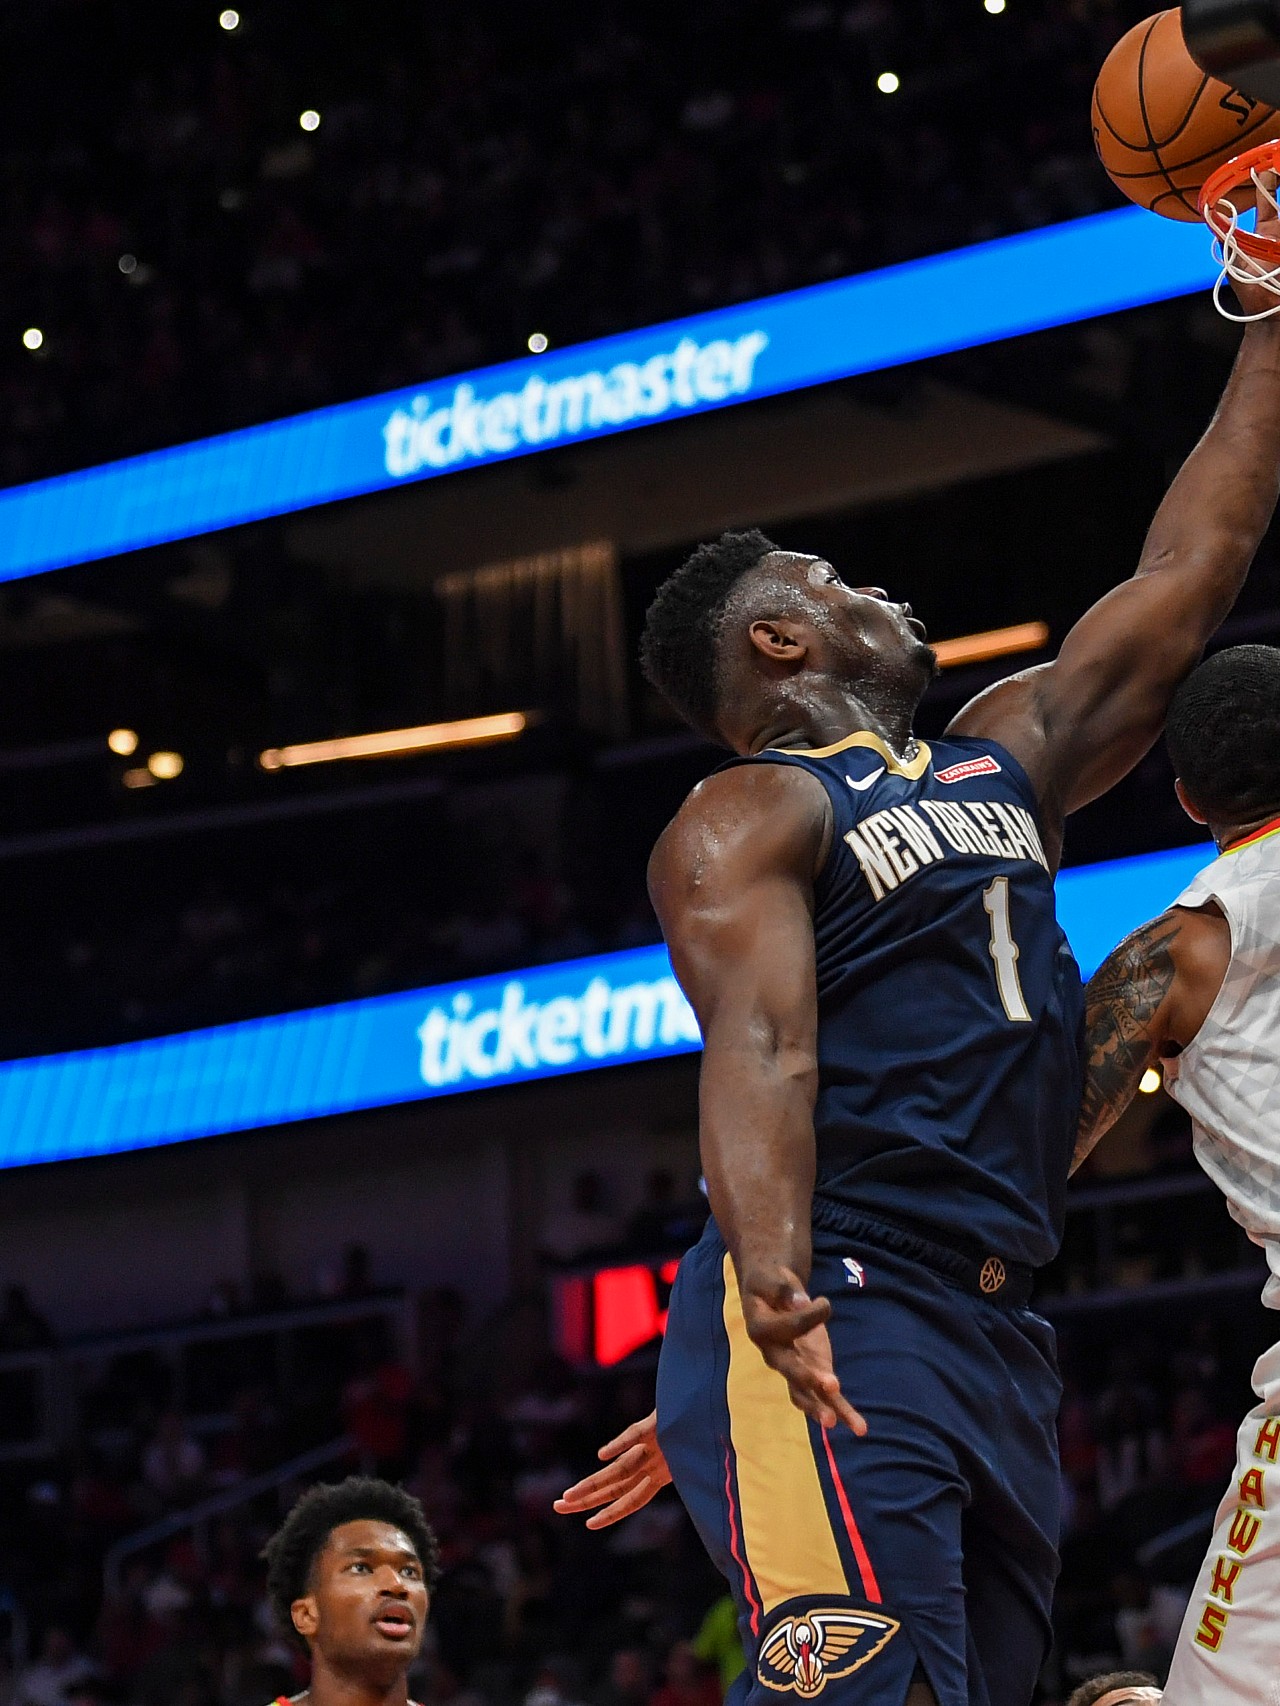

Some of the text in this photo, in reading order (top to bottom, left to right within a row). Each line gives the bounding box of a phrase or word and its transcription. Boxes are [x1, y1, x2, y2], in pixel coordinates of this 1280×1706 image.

[383, 330, 769, 478] ticketmaster
[843, 799, 1050, 902] NEW ORLEAN
[982, 876, 1033, 1022] 1
